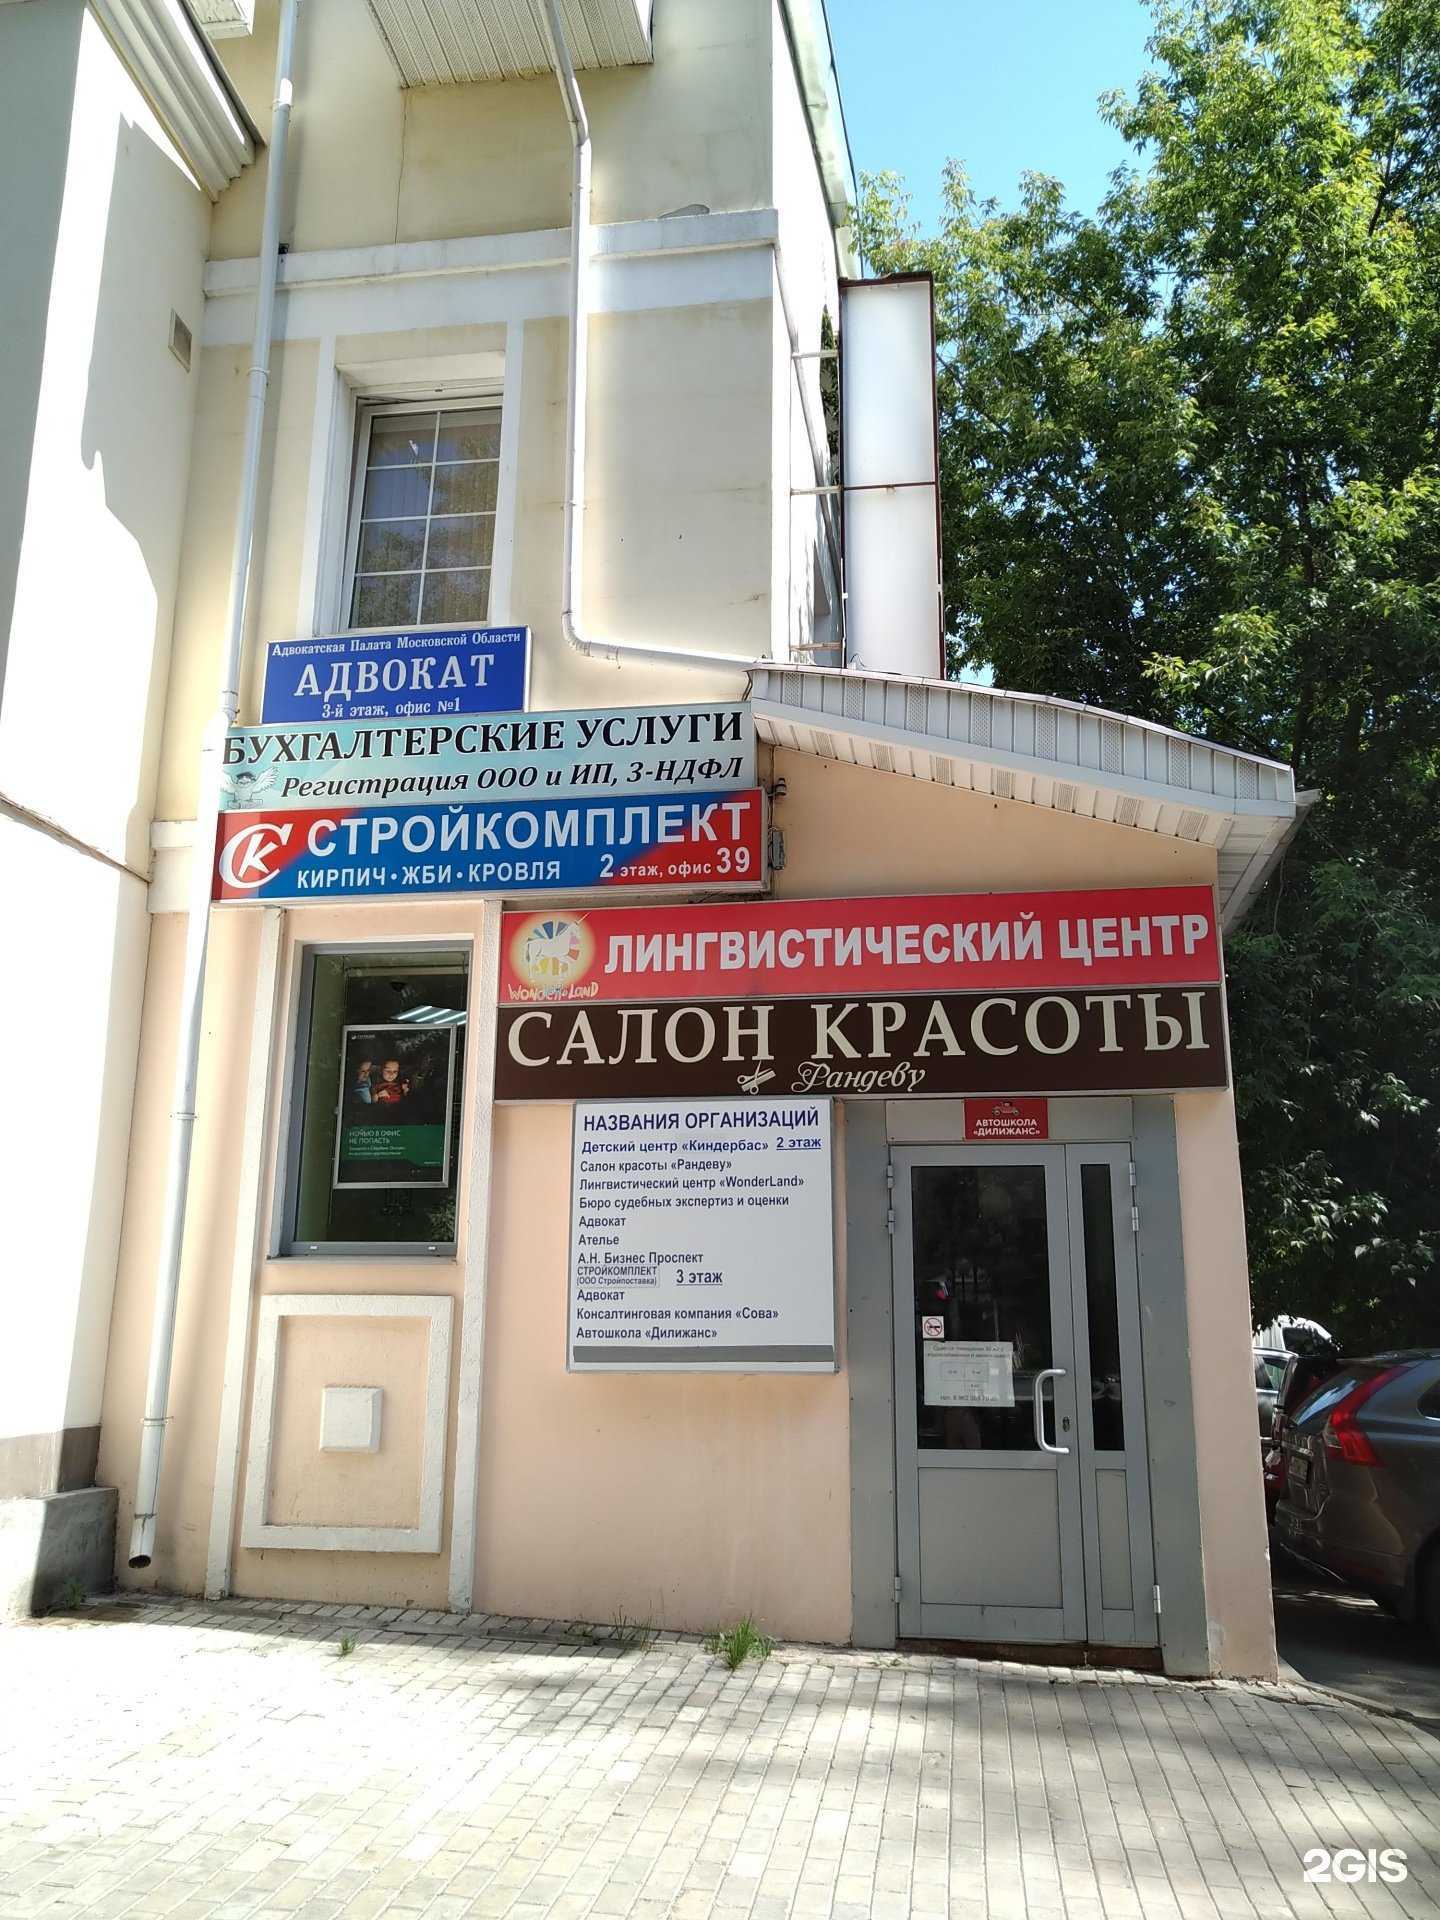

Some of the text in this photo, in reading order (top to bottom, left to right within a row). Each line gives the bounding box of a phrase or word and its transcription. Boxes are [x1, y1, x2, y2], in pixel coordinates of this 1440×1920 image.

[272, 632, 520, 656] Адвокатская Палата Московской Области
[294, 654, 495, 702] АДВОКАТ
[322, 697, 460, 718] 3-й этаж, офис №1
[223, 712, 742, 765] БУХГАЛТЕРСКИЕ УСЛУГИ
[280, 756, 744, 798] Регистрация ООО и ИП, 3-НДФЛ
[307, 802, 750, 857] СТРОЙКОМПЛЕКТ
[600, 847, 750, 878] 2 этаж, офис 39
[297, 861, 560, 888] КИРПИЧ ЖБИ КРОВЛЯ
[604, 911, 1208, 974] ЛИНГВИСТИЧЕСКИЙ ЦЕНТР
[508, 991, 1210, 1067] САЛОН КРАСОТЫ
[791, 1061, 926, 1093] Рандеву
[584, 1105, 819, 1131] НАЗВАНИЯ ОРГАНИЗАЦИЙ
[976, 1119, 1037, 1127] АВТОШКОЛА
[974, 1128, 1040, 1136] «ДИЛИЖАНС»
[582, 1139, 768, 1153] Детский центр «Киндербас»
[776, 1136, 821, 1148] 2 этаж
[580, 1158, 731, 1173] Салон красоты «Рандеву»
[580, 1176, 804, 1191] Лингвистический центр «WonderLand»
[579, 1196, 789, 1210] Бюро судебных экспертиз и оценки
[579, 1216, 626, 1229] Адвокат
[579, 1235, 619, 1245] Ателье
[578, 1252, 703, 1265] А.Н. Бизнес Проспект
[577, 1265, 657, 1275] СТРОЙКОМПЛЕКТ
[677, 1269, 722, 1283] 3 этаж
[577, 1278, 595, 1286] (ООО
[577, 1290, 624, 1302] Адвокат
[577, 1308, 778, 1320] Консалтинговая компания «Сова»
[577, 1327, 717, 1340] Автошкола «Дилижанс»
